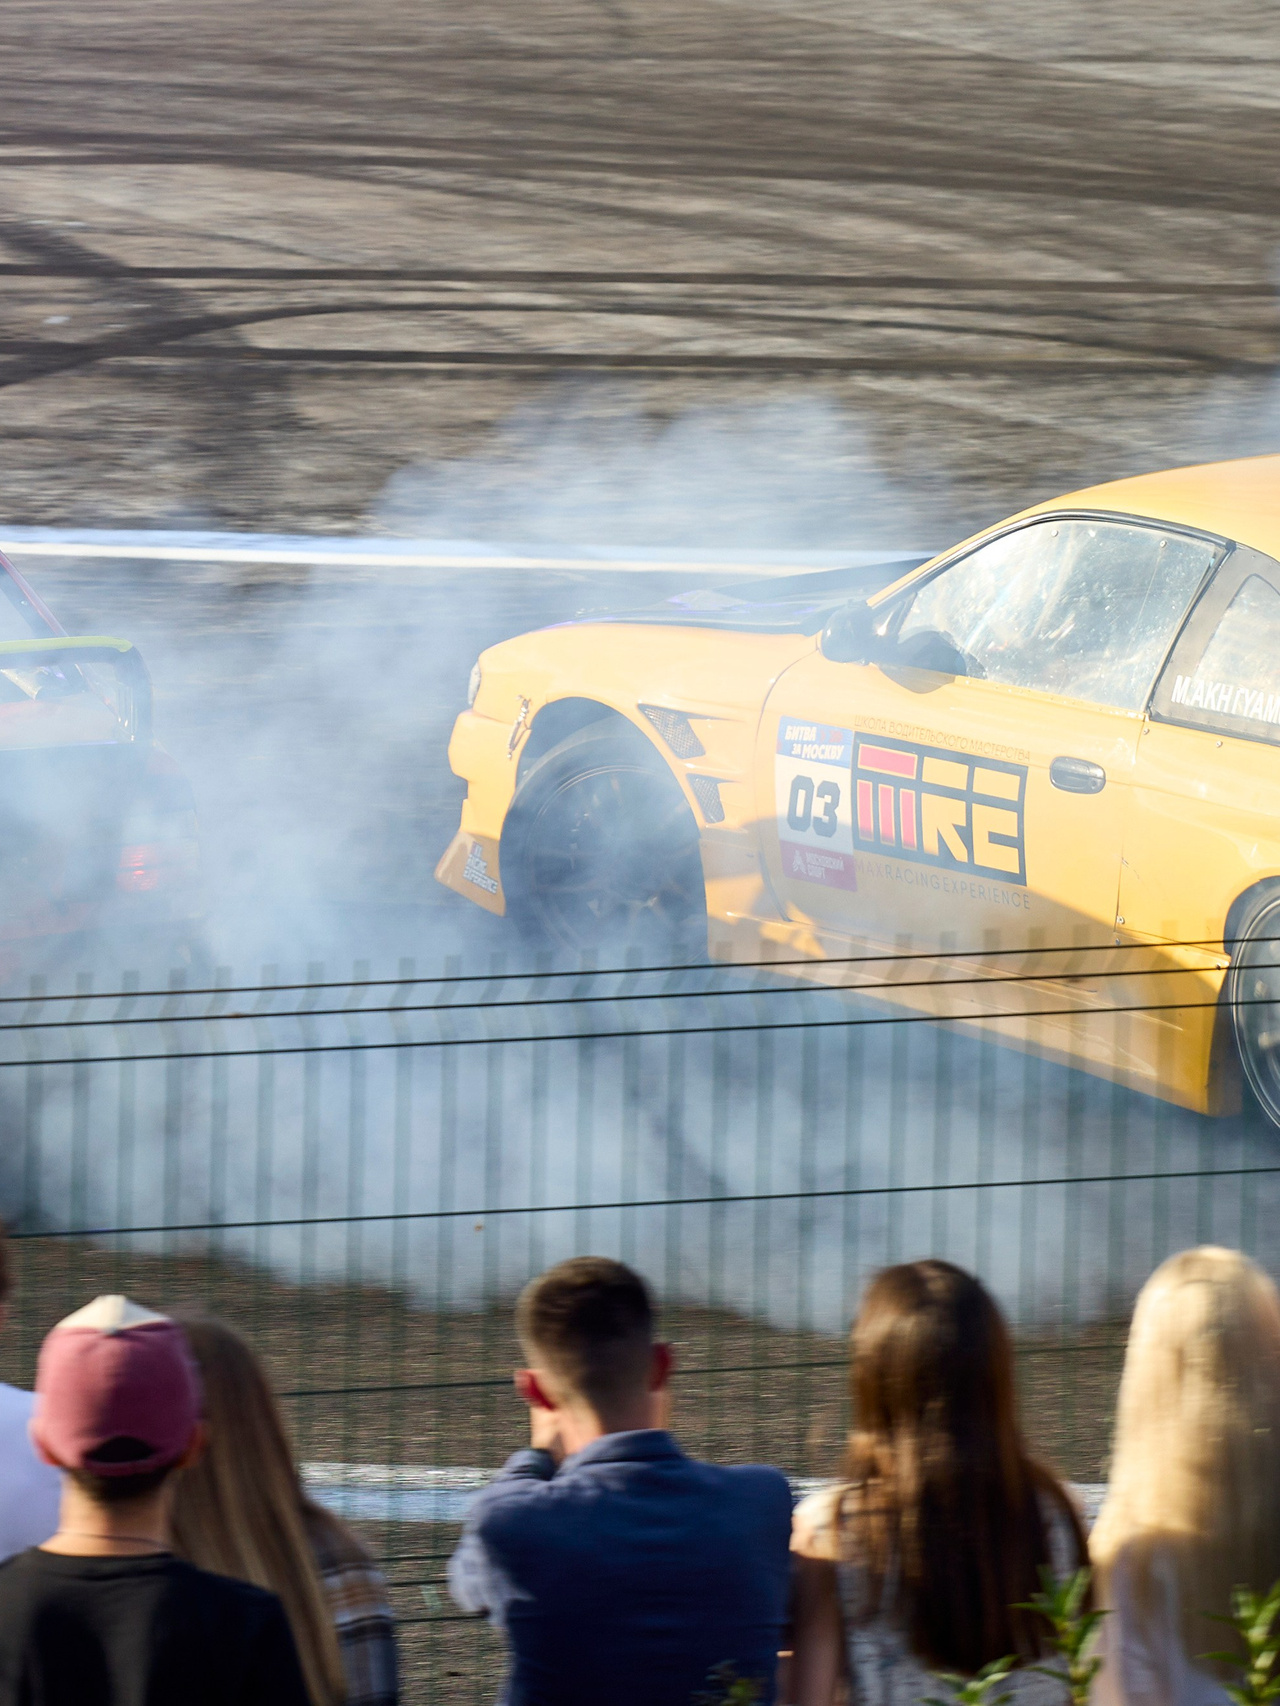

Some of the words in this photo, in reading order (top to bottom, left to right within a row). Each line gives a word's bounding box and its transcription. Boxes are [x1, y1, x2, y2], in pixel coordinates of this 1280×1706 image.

[785, 725, 817, 741] БИТВА
[854, 715, 886, 731] ШКОЛА
[888, 721, 968, 750] ВОДИТЕЛЬСКОГО
[970, 738, 1031, 763] МАСТЕРСТВА
[791, 743, 802, 755] ЗА
[802, 744, 845, 760] МОСКВУ
[786, 774, 841, 838] 03
